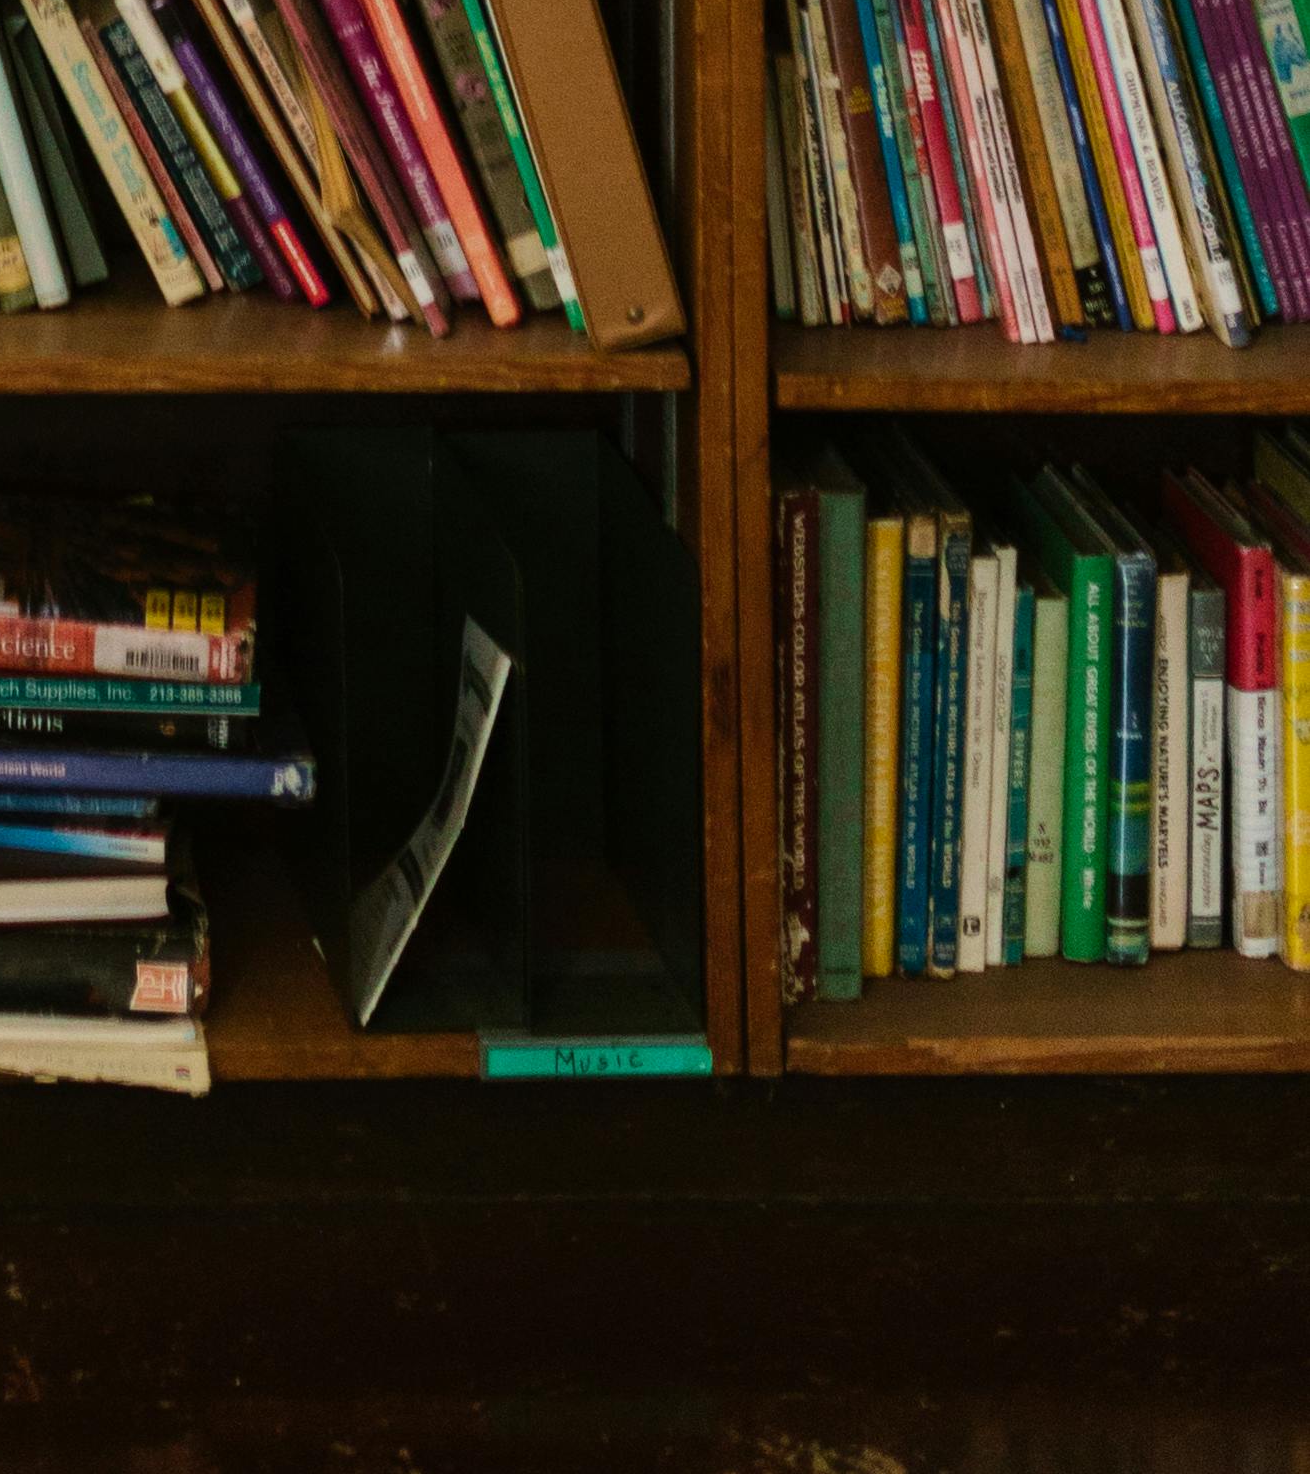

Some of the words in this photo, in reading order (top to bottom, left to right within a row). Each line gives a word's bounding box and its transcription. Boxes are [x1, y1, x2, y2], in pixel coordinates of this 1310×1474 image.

[25, 681, 101, 702] Supplies,
[107, 684, 135, 701] Inc.
[1195, 765, 1221, 835] MAPS
[555, 1047, 645, 1078] Music
